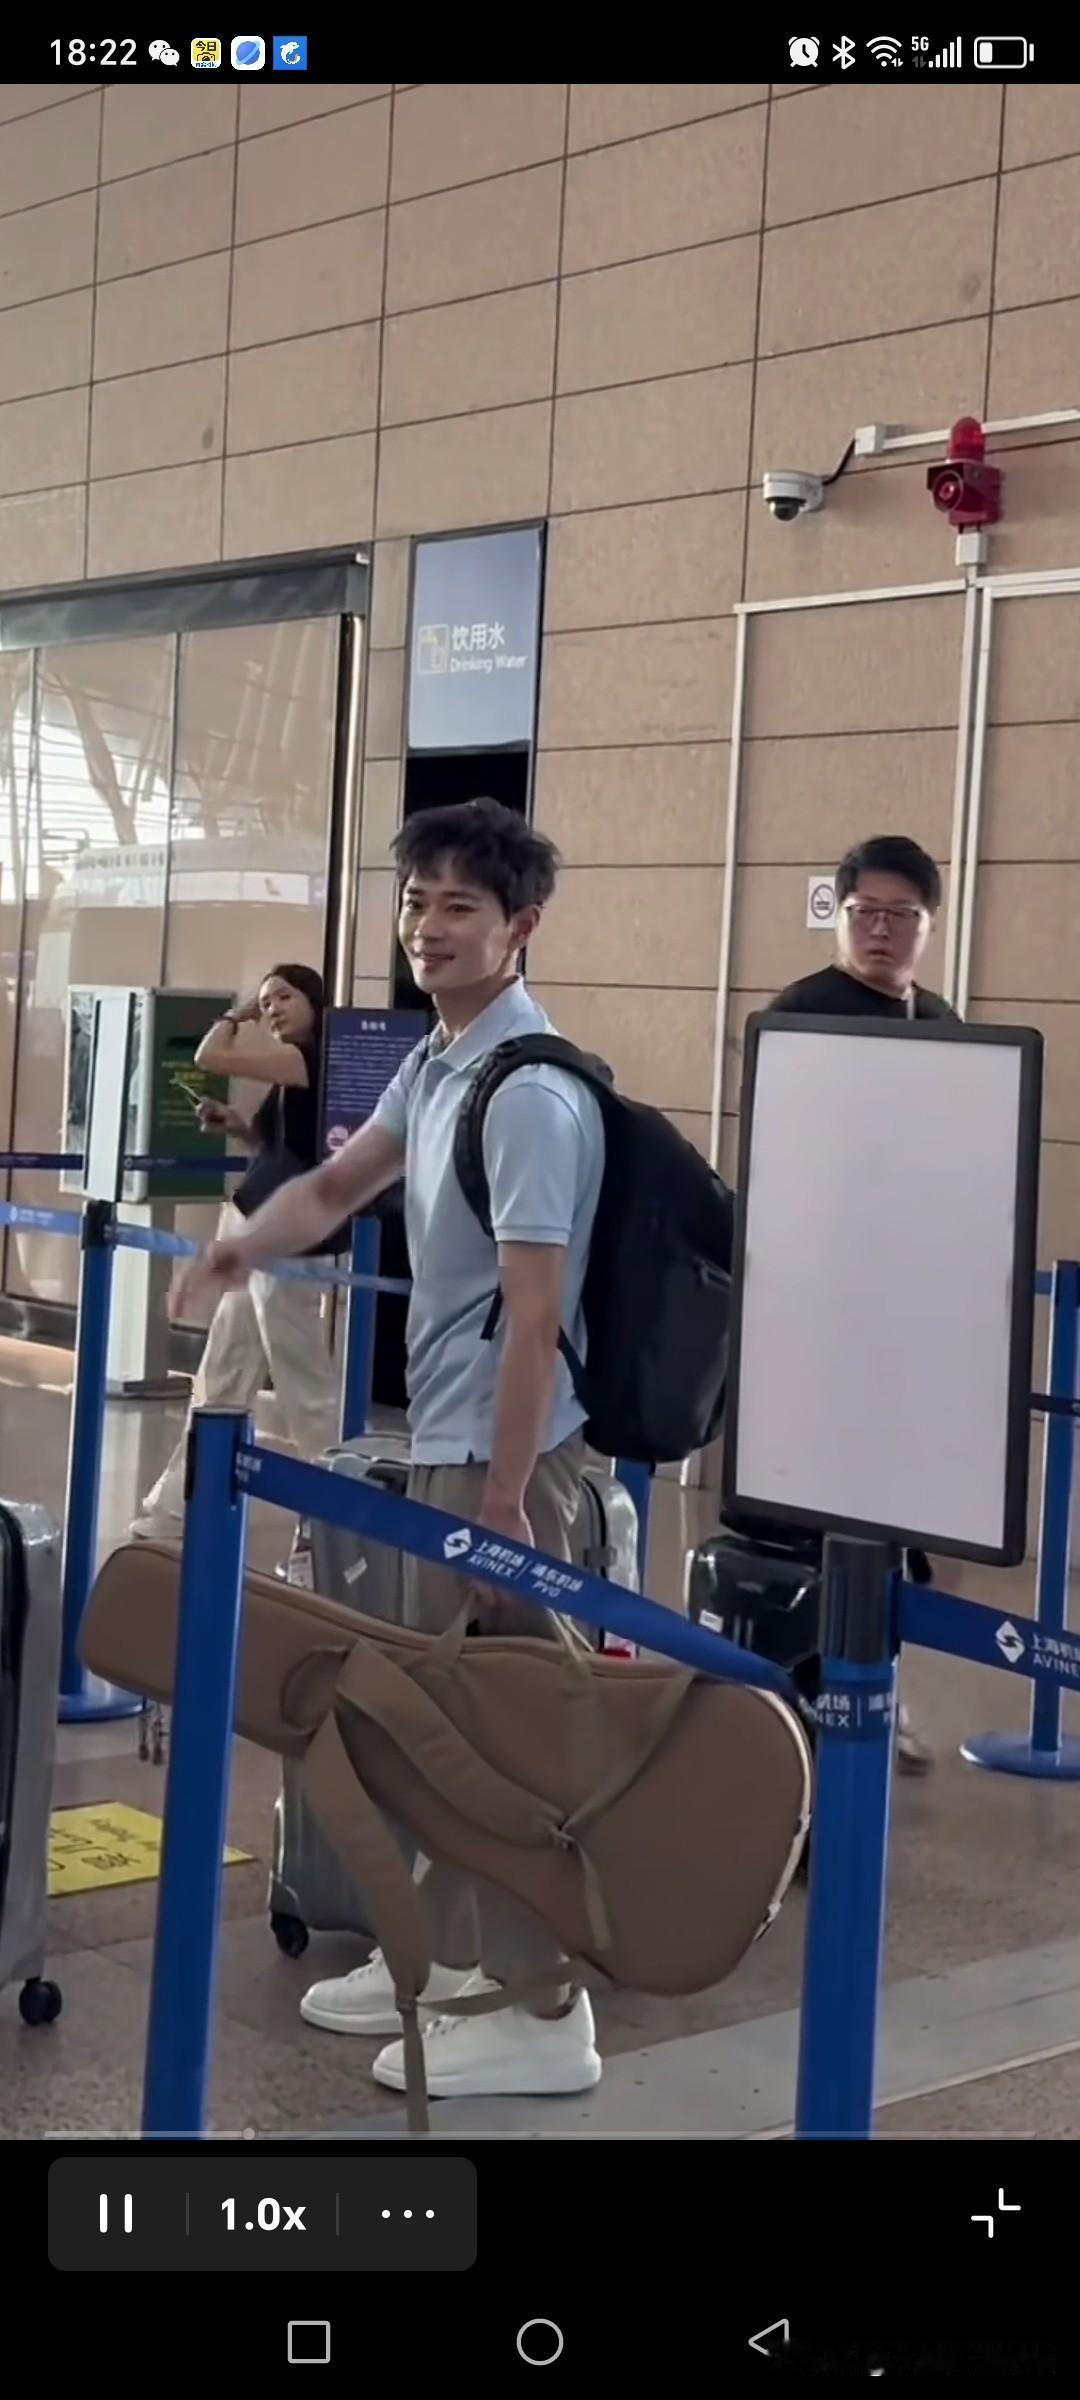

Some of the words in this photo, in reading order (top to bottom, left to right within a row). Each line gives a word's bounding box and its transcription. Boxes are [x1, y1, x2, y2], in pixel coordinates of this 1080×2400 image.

[452, 622, 505, 651] 饮用水
[450, 657, 493, 674] Drinking
[495, 655, 528, 669] Water
[467, 1553, 515, 1578] AVINEX
[474, 1539, 526, 1568] 上海机场
[530, 1562, 584, 1593] 浦东机场
